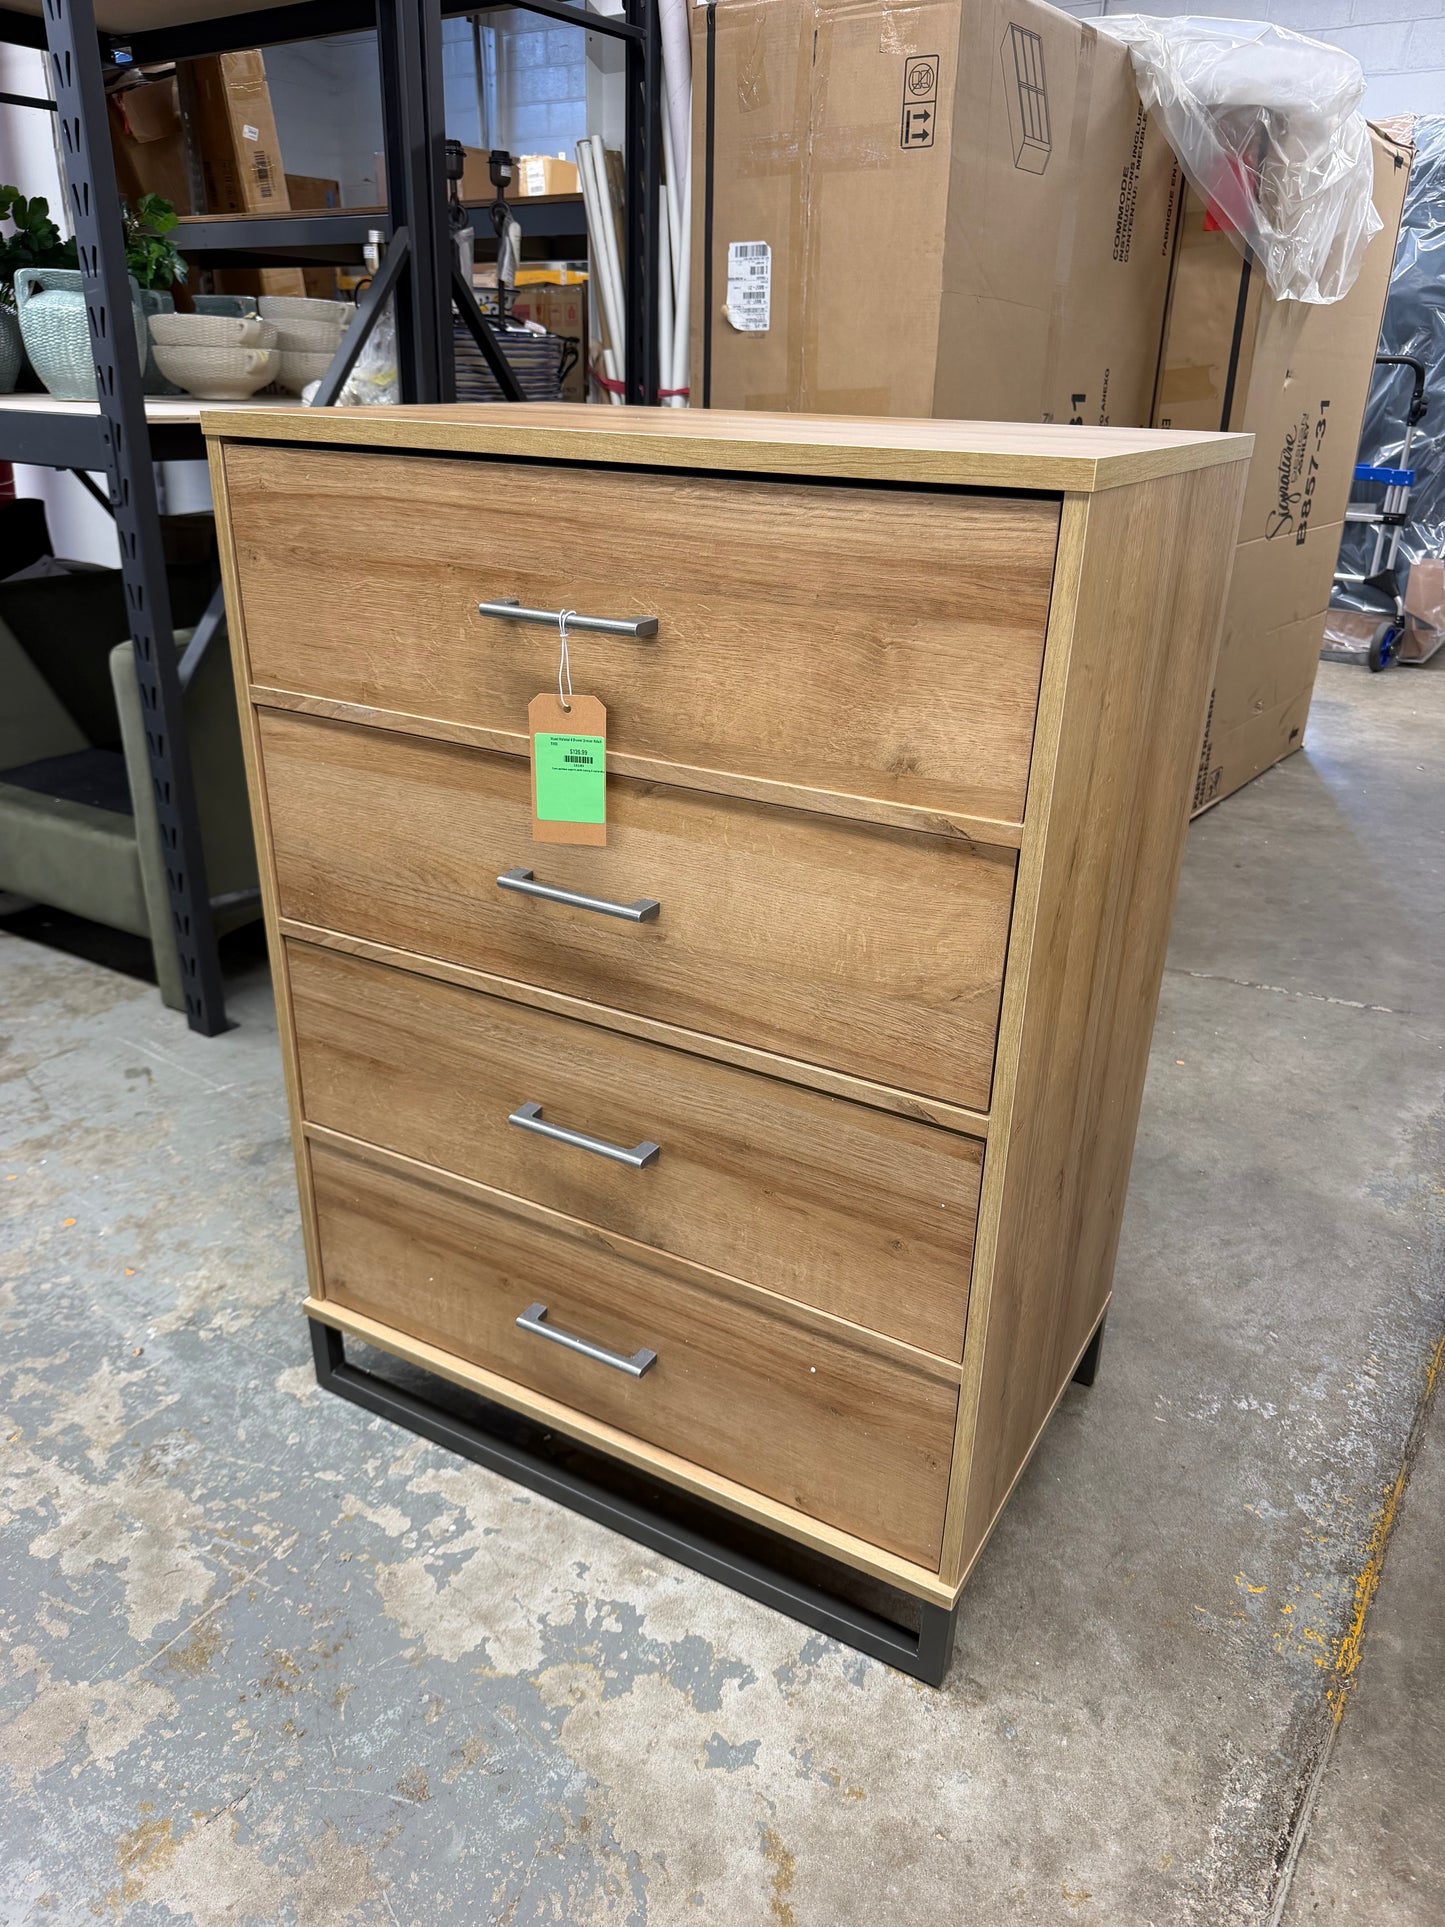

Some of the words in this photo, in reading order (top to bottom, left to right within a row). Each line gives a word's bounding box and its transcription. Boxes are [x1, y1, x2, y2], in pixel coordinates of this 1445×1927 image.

[1113, 166, 1129, 260] COMMODE
[1119, 162, 1135, 262] INSTRUCTIONS
[1265, 424, 1301, 541] Signature
[1296, 400, 1331, 546] B857-31
